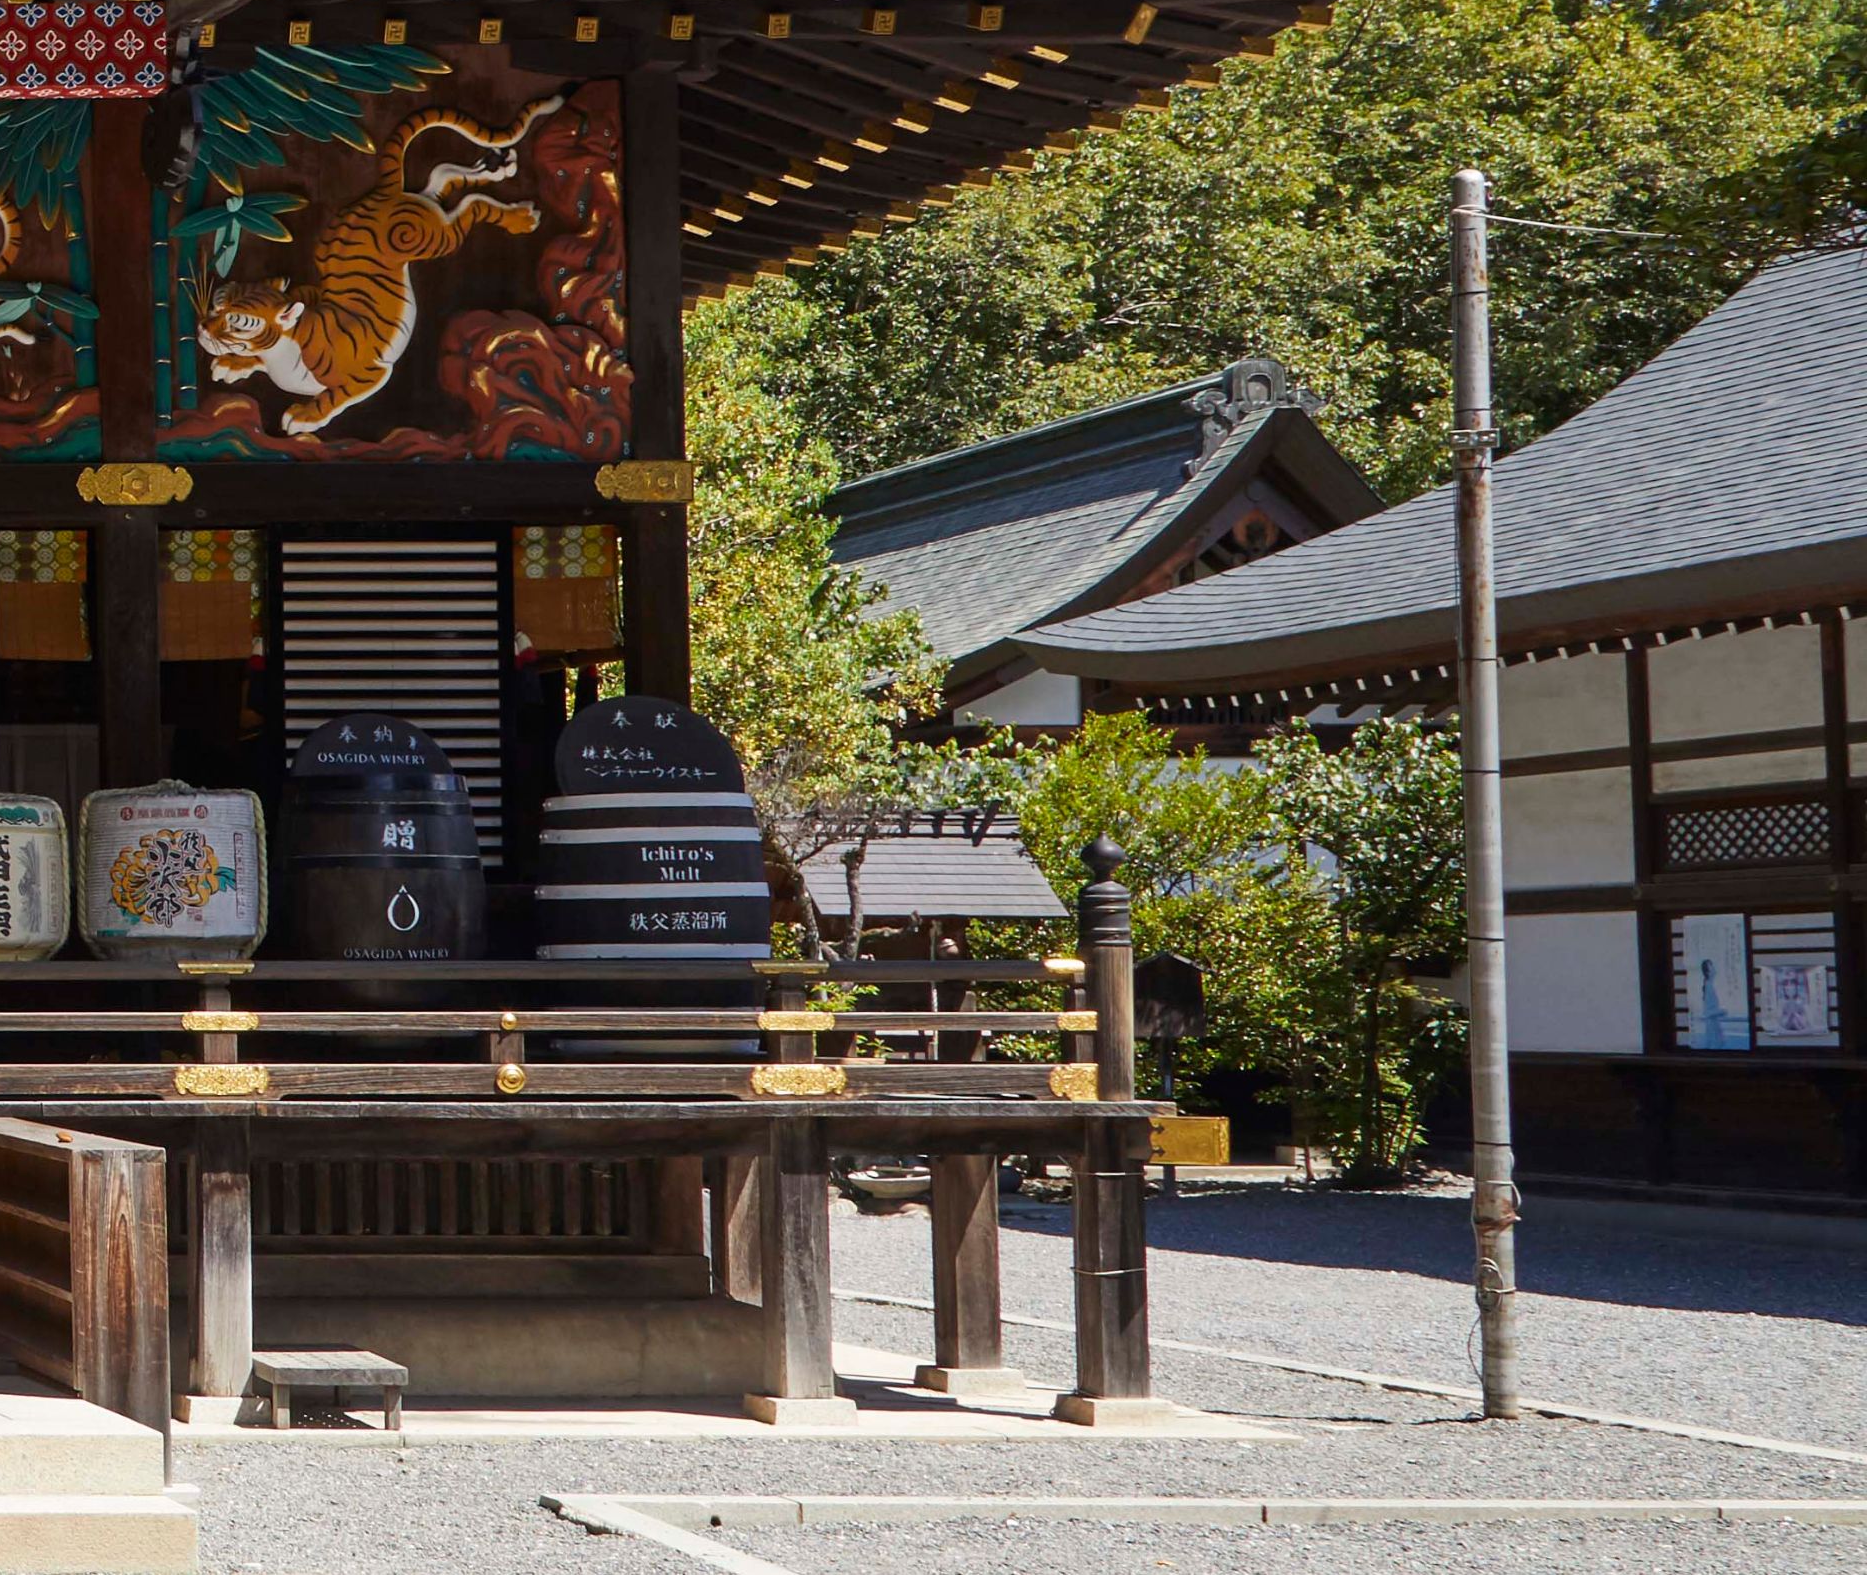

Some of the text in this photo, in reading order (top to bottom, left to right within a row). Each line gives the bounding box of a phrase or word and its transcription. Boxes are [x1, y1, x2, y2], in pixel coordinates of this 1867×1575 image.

[612, 710, 678, 729] 奉献
[381, 754, 426, 766] WINERY
[581, 746, 655, 761] 株式会社
[584, 765, 718, 780] ベンチャーウイスキー
[382, 820, 416, 850] 贈
[641, 846, 714, 862] Ichiro's
[661, 867, 700, 881] Malt
[630, 911, 728, 930] 秩父蒸溜所
[408, 947, 449, 959] WINERY
